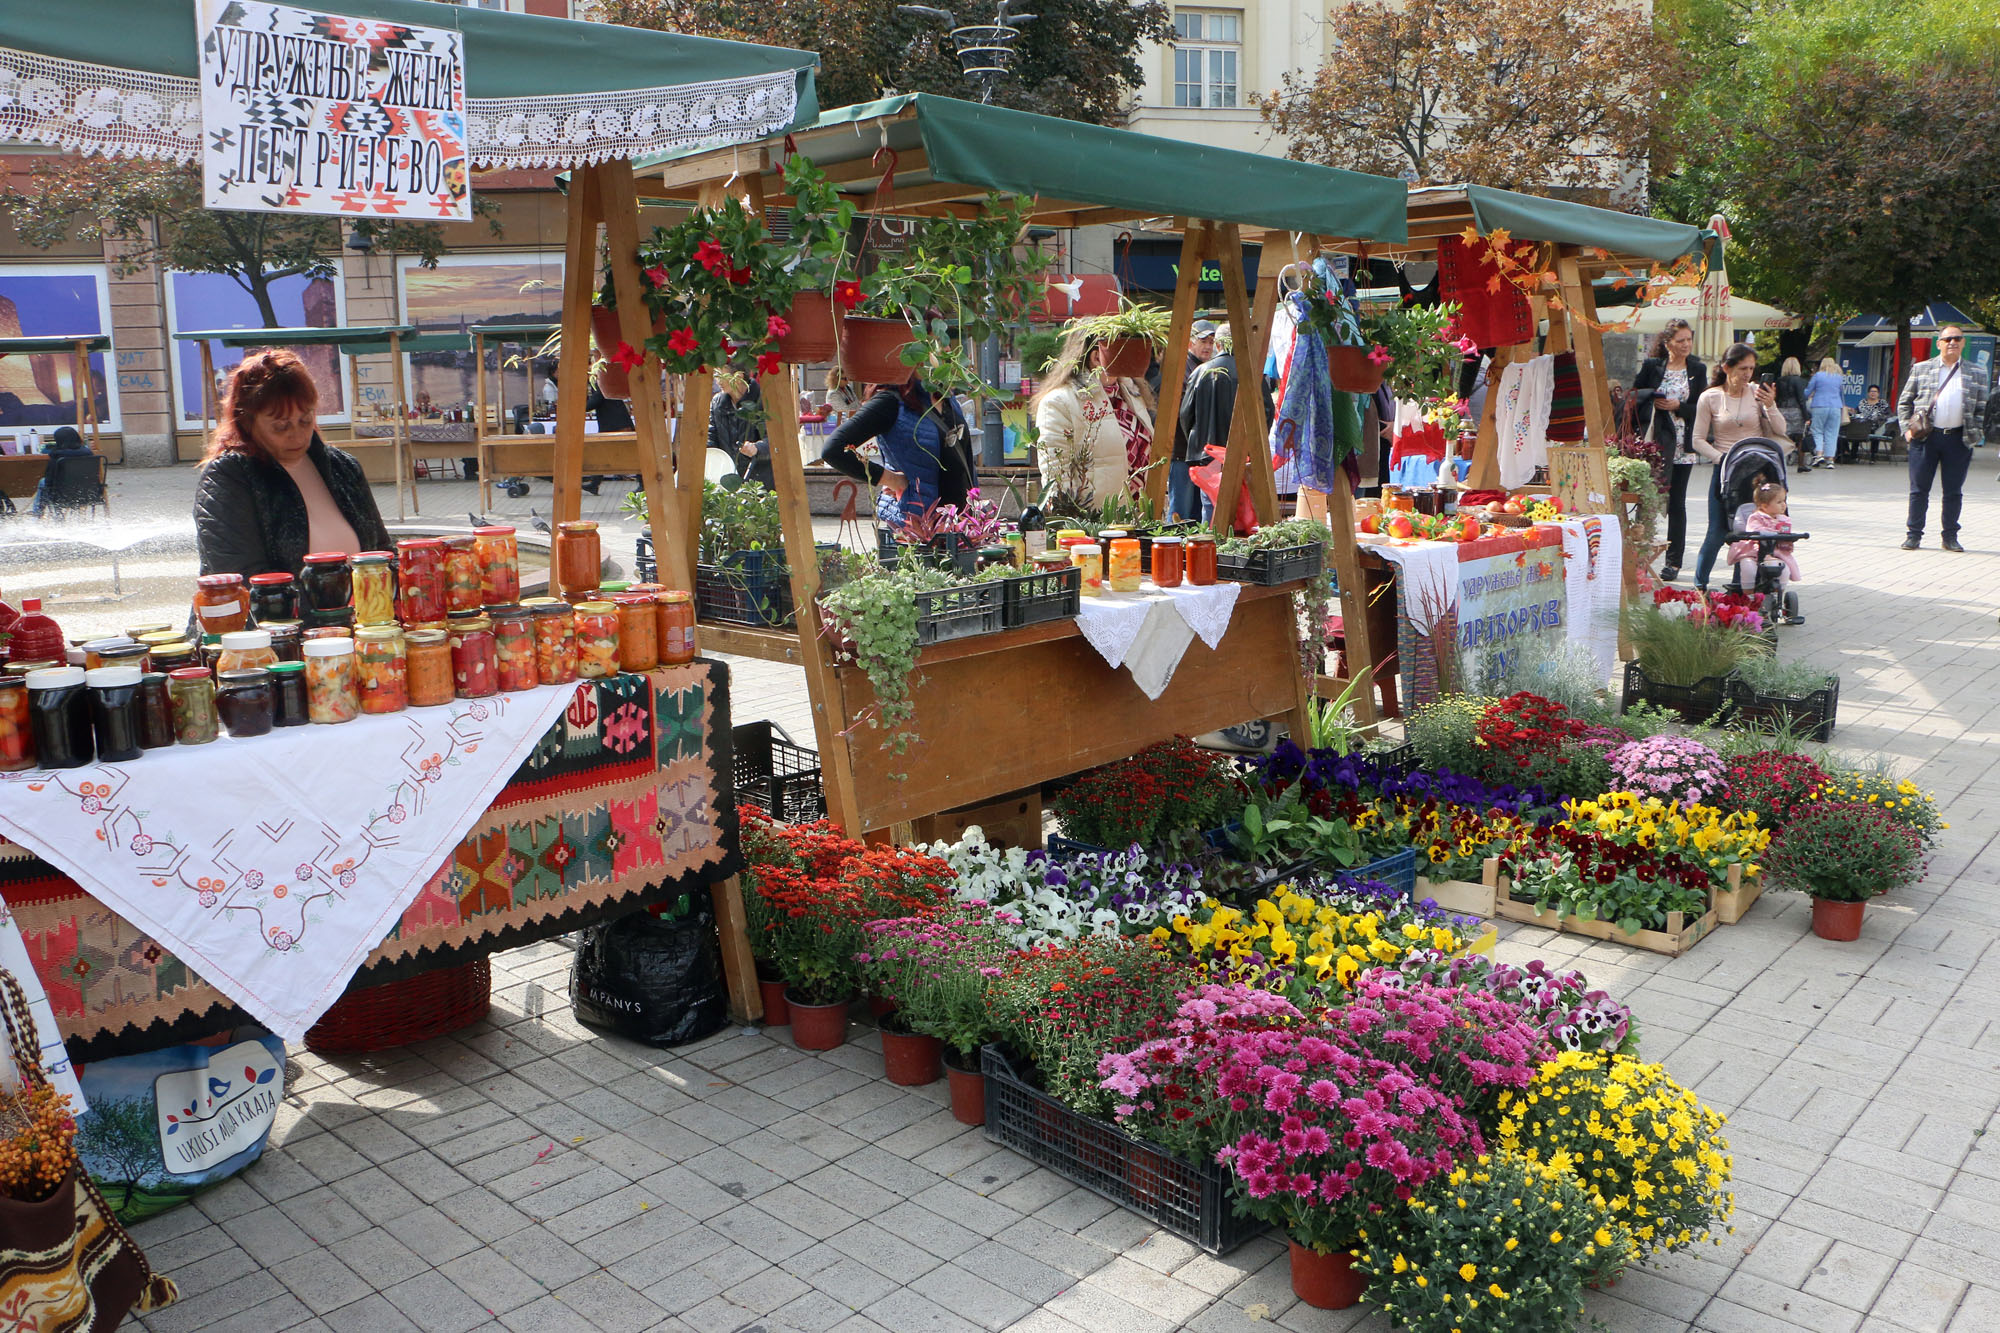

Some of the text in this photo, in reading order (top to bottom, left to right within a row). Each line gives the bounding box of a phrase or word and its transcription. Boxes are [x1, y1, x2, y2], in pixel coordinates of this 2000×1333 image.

[214, 27, 454, 111] УДРУЖЕЊЕ ЖЕНА
[236, 125, 441, 195] ПЕТРИЈЕВО
[176, 1128, 220, 1163] UKUSI
[234, 1089, 276, 1124] KRAJA
